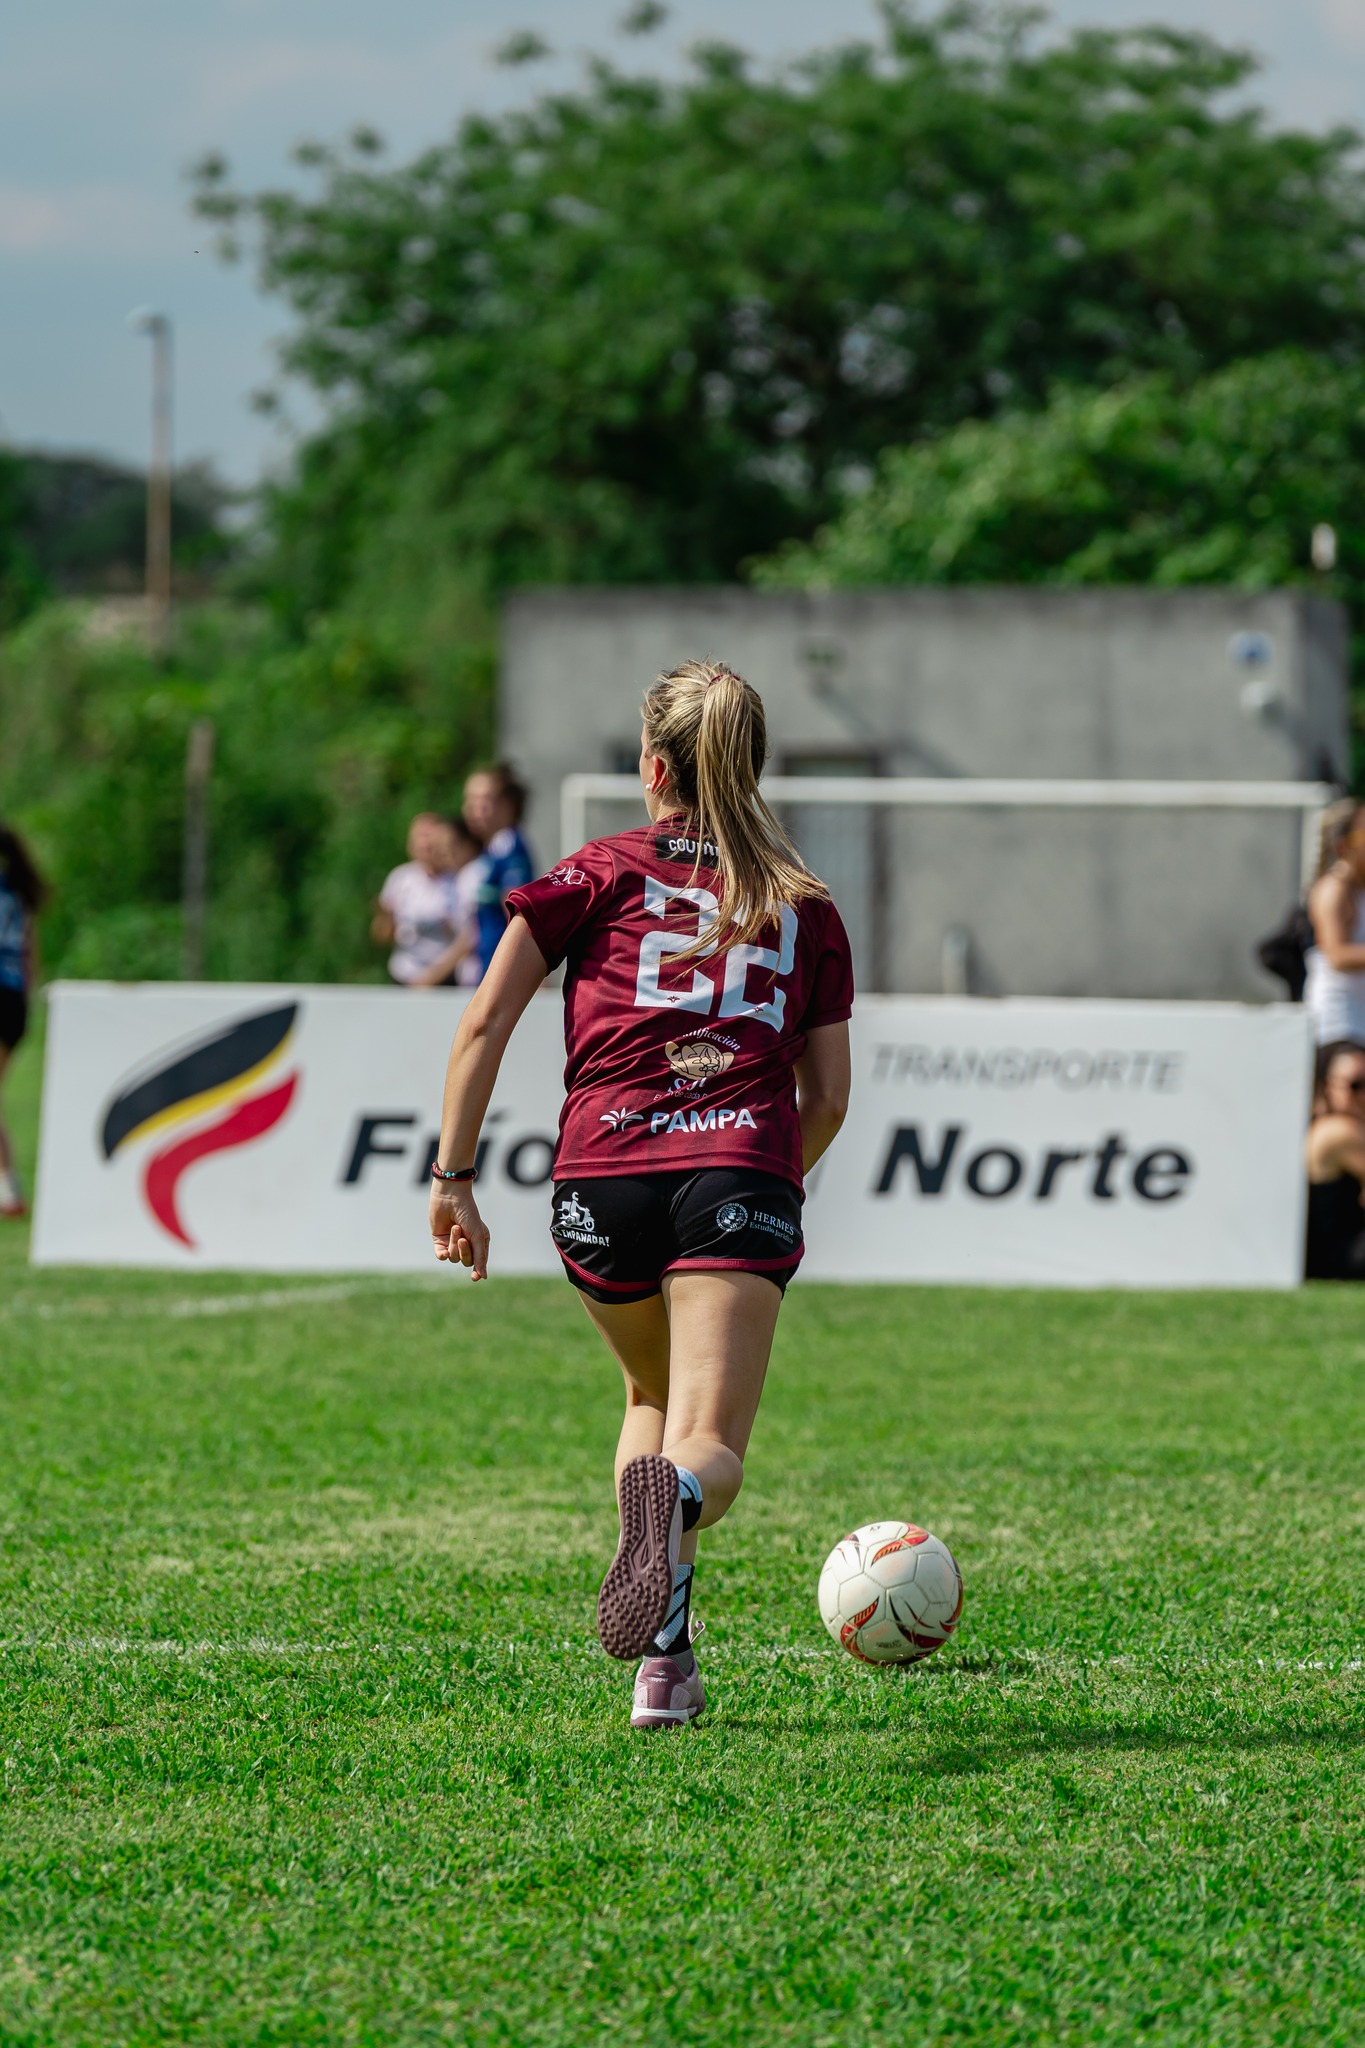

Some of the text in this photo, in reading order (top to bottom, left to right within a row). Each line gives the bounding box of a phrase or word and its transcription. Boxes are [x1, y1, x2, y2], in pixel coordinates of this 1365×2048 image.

[634, 875, 798, 1033] 22
[872, 1044, 1184, 1092] TRANSPORTE
[650, 1108, 757, 1134] PAMPA
[873, 1121, 1193, 1204] Norte
[750, 1222, 775, 1234] Estudio
[753, 1211, 794, 1236] HERMES
